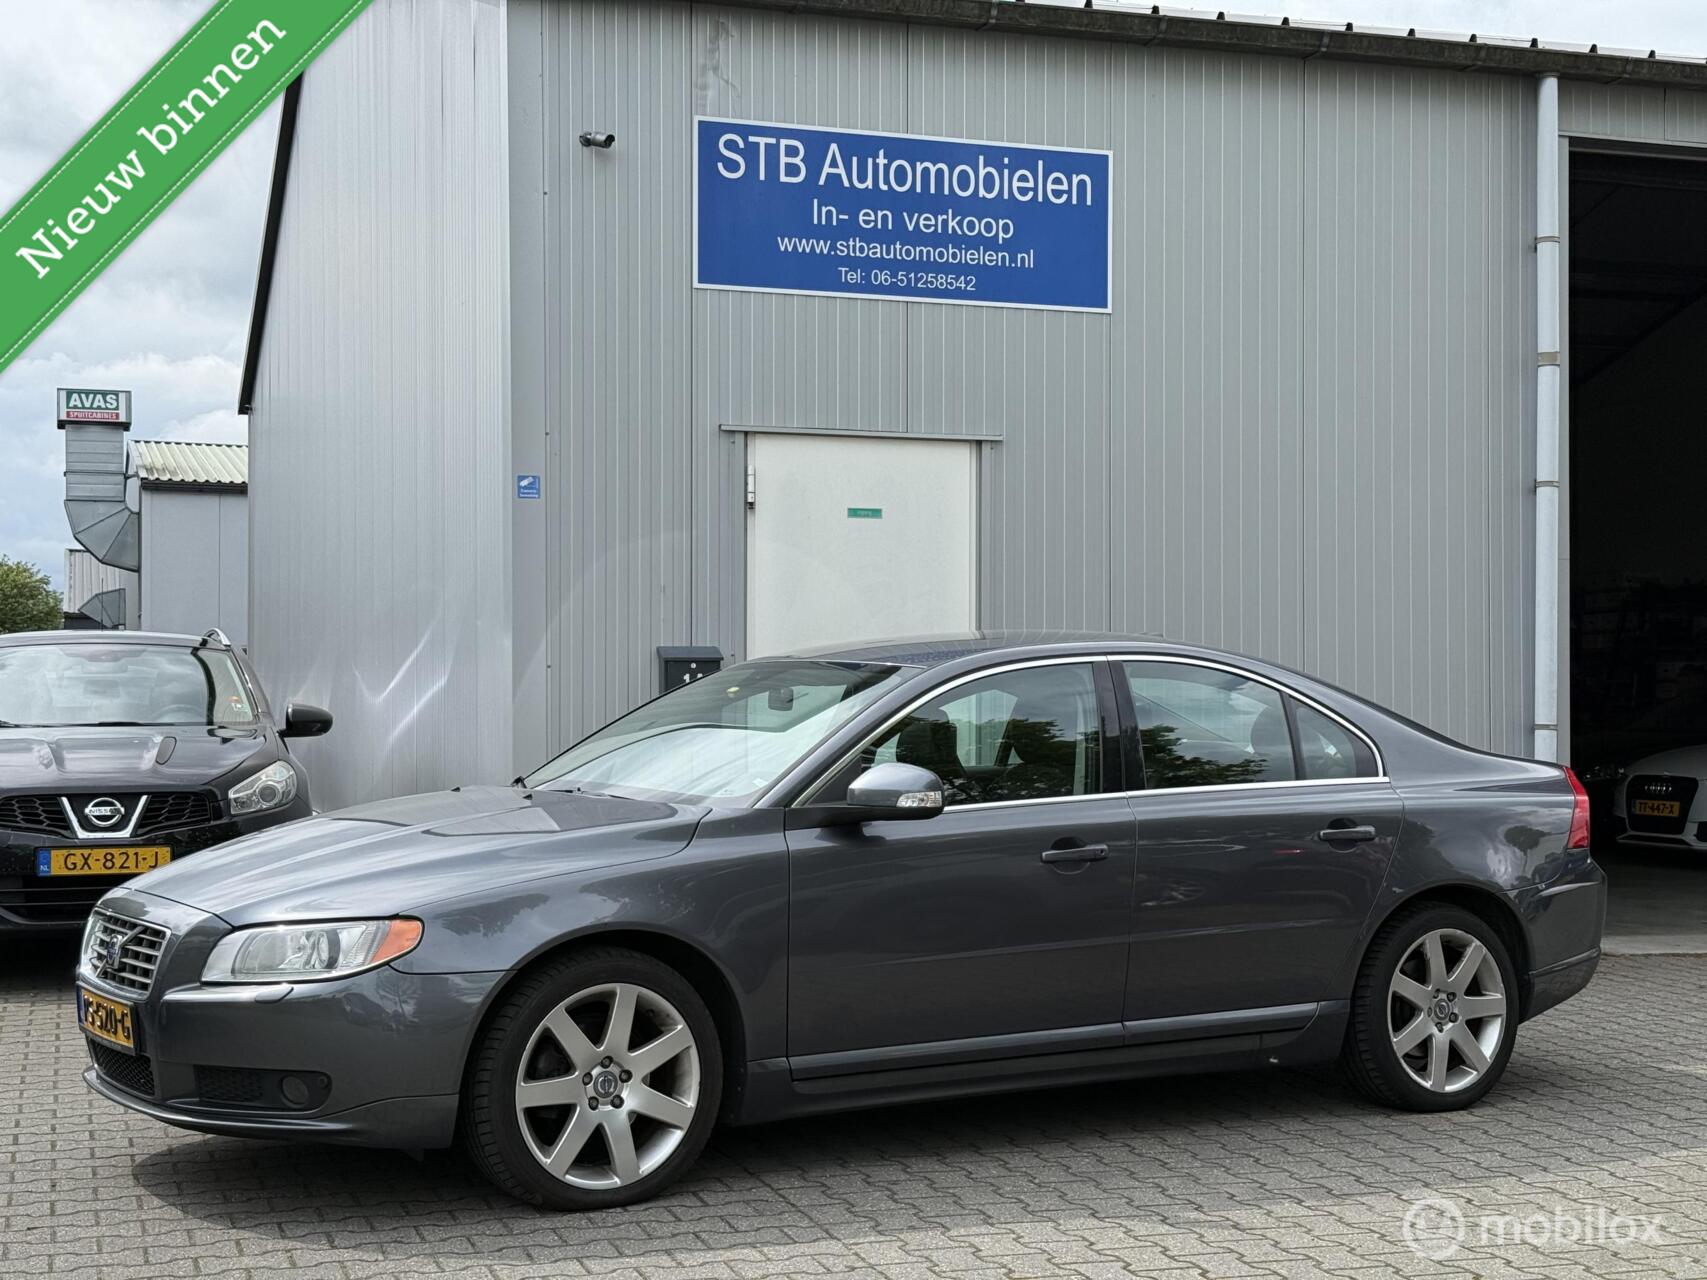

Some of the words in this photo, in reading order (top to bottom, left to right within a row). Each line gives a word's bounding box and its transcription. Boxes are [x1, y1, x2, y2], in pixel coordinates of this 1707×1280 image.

[716, 133, 807, 184] STB
[818, 142, 1093, 206] Automobielen
[812, 198, 849, 226] In-
[858, 206, 893, 230] en
[903, 209, 1014, 244] verkoop
[777, 235, 1034, 268] www.stbautomobielen.nl
[838, 267, 866, 285] Tel:
[871, 269, 977, 291] 06-51258542
[69, 393, 118, 408] AVAS
[63, 851, 159, 871] GX-821-J
